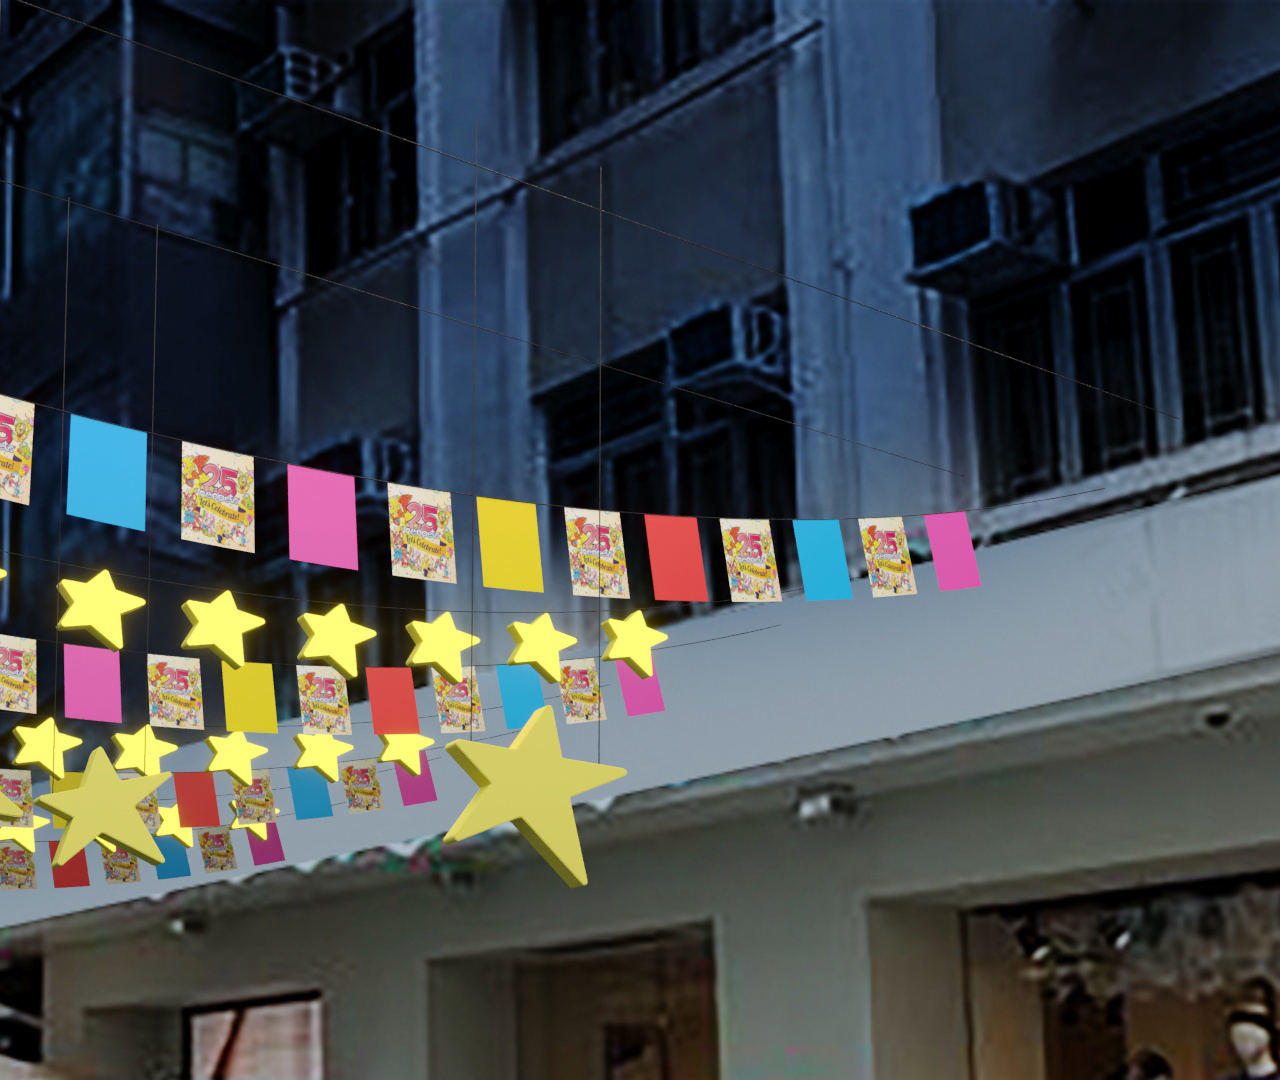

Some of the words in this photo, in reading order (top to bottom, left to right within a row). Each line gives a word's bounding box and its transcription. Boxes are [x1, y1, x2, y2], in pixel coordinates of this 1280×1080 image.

[201, 463, 239, 497] 25
[406, 501, 438, 533] 25
[581, 523, 611, 552] 25
[736, 532, 763, 560] 25
[873, 530, 898, 557] 25
[162, 667, 189, 691] 25
[311, 677, 336, 700] 25
[568, 670, 590, 691] 25
[351, 768, 370, 786] 25
[6, 849, 26, 866] 25
